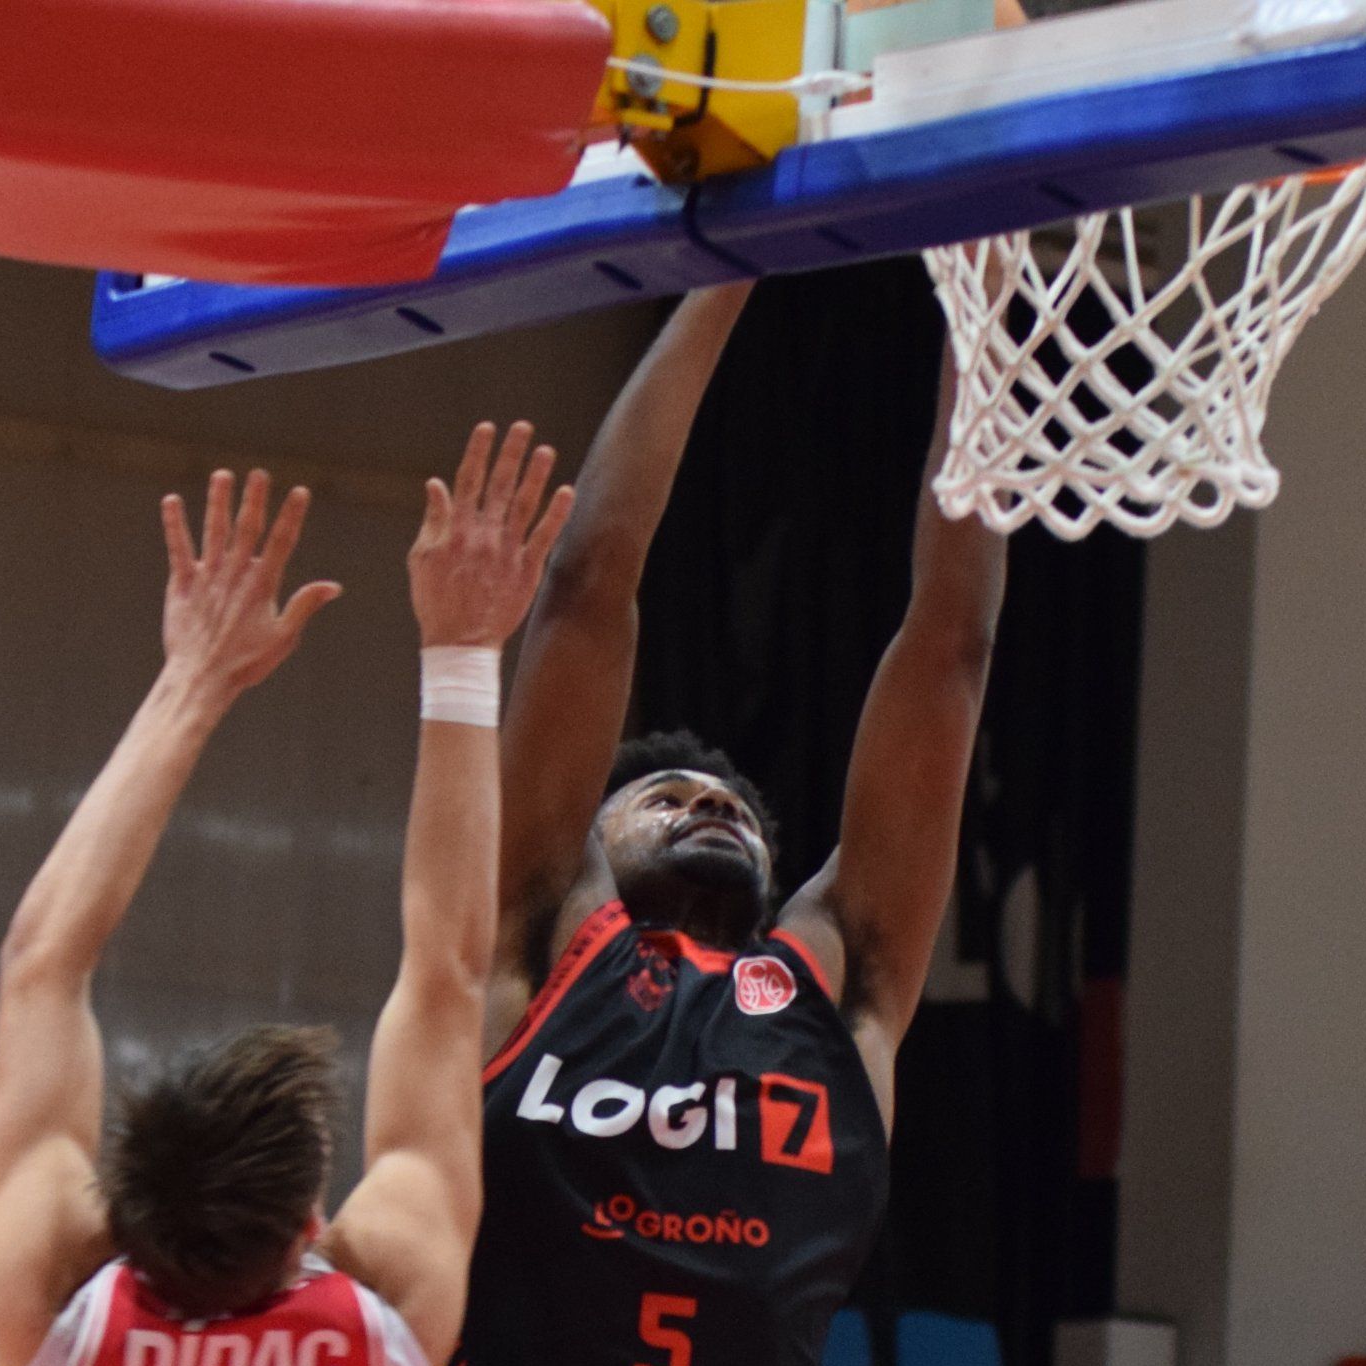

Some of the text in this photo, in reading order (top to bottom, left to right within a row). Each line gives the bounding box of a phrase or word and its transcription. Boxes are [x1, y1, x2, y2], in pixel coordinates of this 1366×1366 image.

[516, 1053, 823, 1159] LOGI 7
[592, 1193, 771, 1248] LOGROÑO
